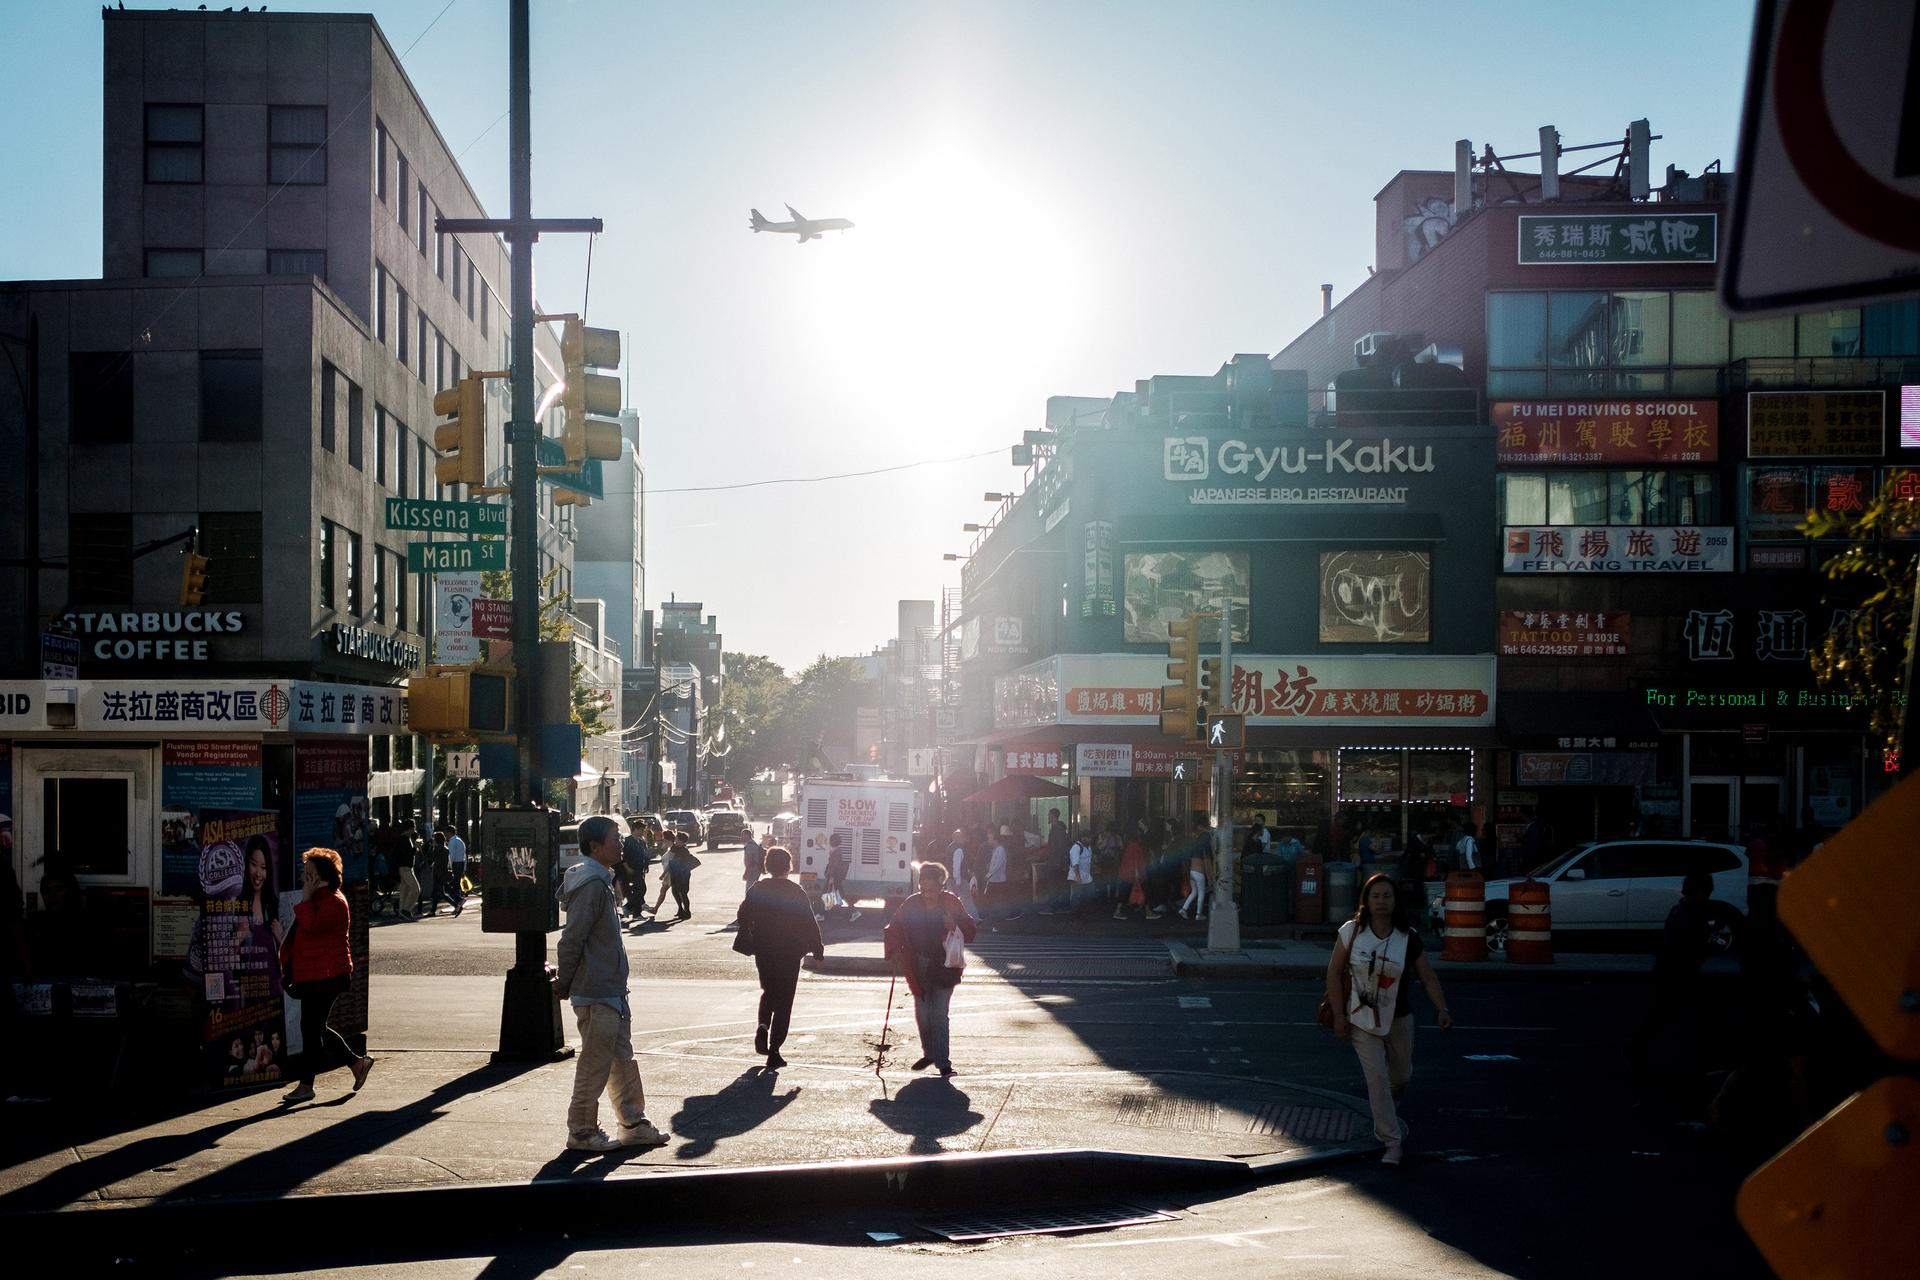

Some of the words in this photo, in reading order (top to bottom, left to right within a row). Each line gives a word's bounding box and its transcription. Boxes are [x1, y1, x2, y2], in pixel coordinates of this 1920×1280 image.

[1534, 224, 1611, 246] 秀瑞斯
[1513, 405, 1531, 416] FU
[1536, 405, 1562, 416] MEI
[1567, 404, 1630, 415] DRIVING
[1635, 404, 1697, 415] SCHOOL
[1500, 419, 1710, 449] 福州駕駛學校
[1218, 438, 1436, 482] Gyu-Kaku
[1190, 487, 1266, 502] JAPANESE
[1272, 487, 1304, 502] BBQ
[1308, 487, 1408, 502] RESTAURANT
[390, 501, 469, 529] Kissena
[479, 508, 505, 523] Blvd
[1706, 537, 1727, 546] 205B
[423, 543, 472, 568] Main
[481, 544, 494, 559] St
[1523, 560, 1554, 570] FEI
[1560, 560, 1621, 570] YANG
[1629, 560, 1713, 570] TRAVEL
[474, 603, 484, 611] NO
[63, 610, 243, 633] STARBUCKS
[480, 614, 513, 625] ANYTIM
[336, 623, 391, 663] STARBUCKS
[1510, 631, 1573, 642] TATTOO
[94, 639, 208, 661] COFFEE
[1520, 645, 1579, 654] 646-221-2557
[103, 690, 257, 720] 法拉盛商改區
[1647, 689, 1675, 706] For
[1686, 689, 1766, 706] Personal
[1777, 690, 1790, 706] &
[166, 743, 195, 752] Flushing
[204, 751, 248, 759] Registration
[1135, 751, 1168, 760] 6:30am
[839, 799, 876, 810] SLOW
[203, 819, 225, 846] ASA
[208, 849, 237, 869] ASA
[209, 867, 240, 880] COLLEGE
[210, 1008, 223, 1025] 16
